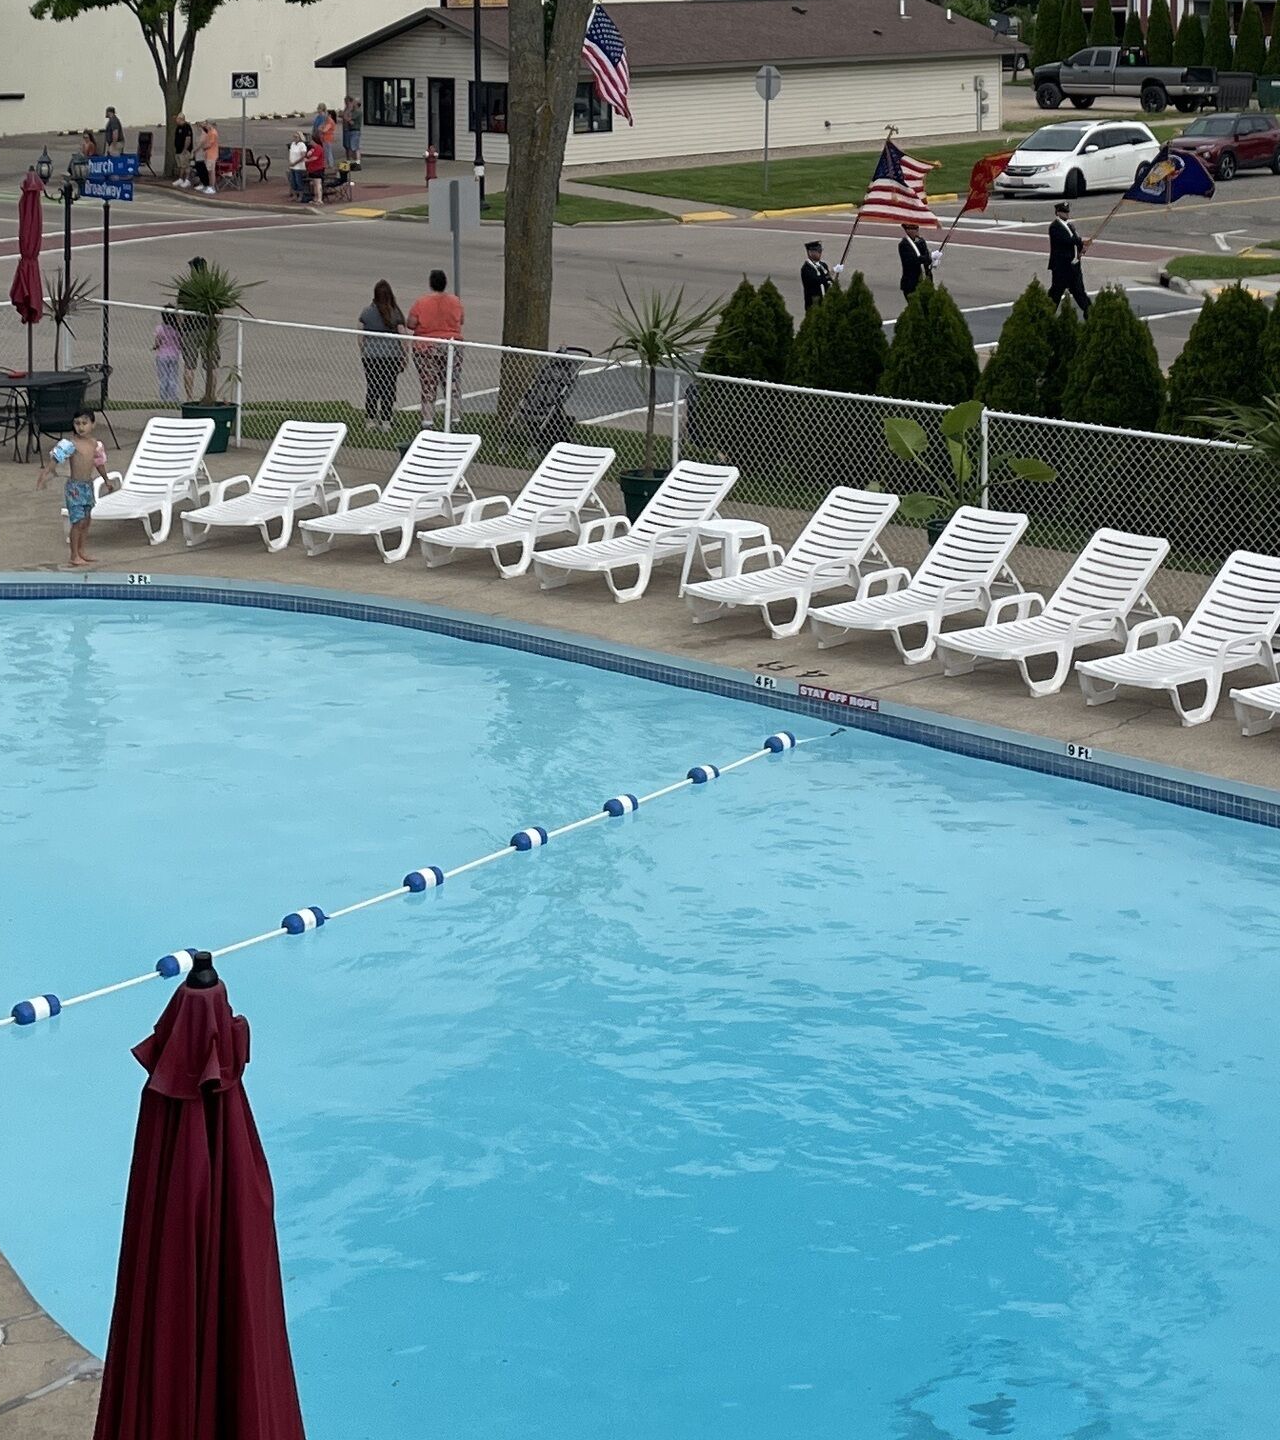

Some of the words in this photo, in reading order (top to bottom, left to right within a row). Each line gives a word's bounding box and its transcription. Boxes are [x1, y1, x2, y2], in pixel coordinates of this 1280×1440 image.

[88, 158, 114, 173] hurch
[84, 179, 122, 199] Broadway
[128, 574, 135, 584] 3
[755, 676, 762, 686] 4
[800, 686, 826, 699] STAY
[828, 691, 847, 703] OFF
[849, 696, 877, 710] ROPE
[1068, 744, 1075, 756] 9
